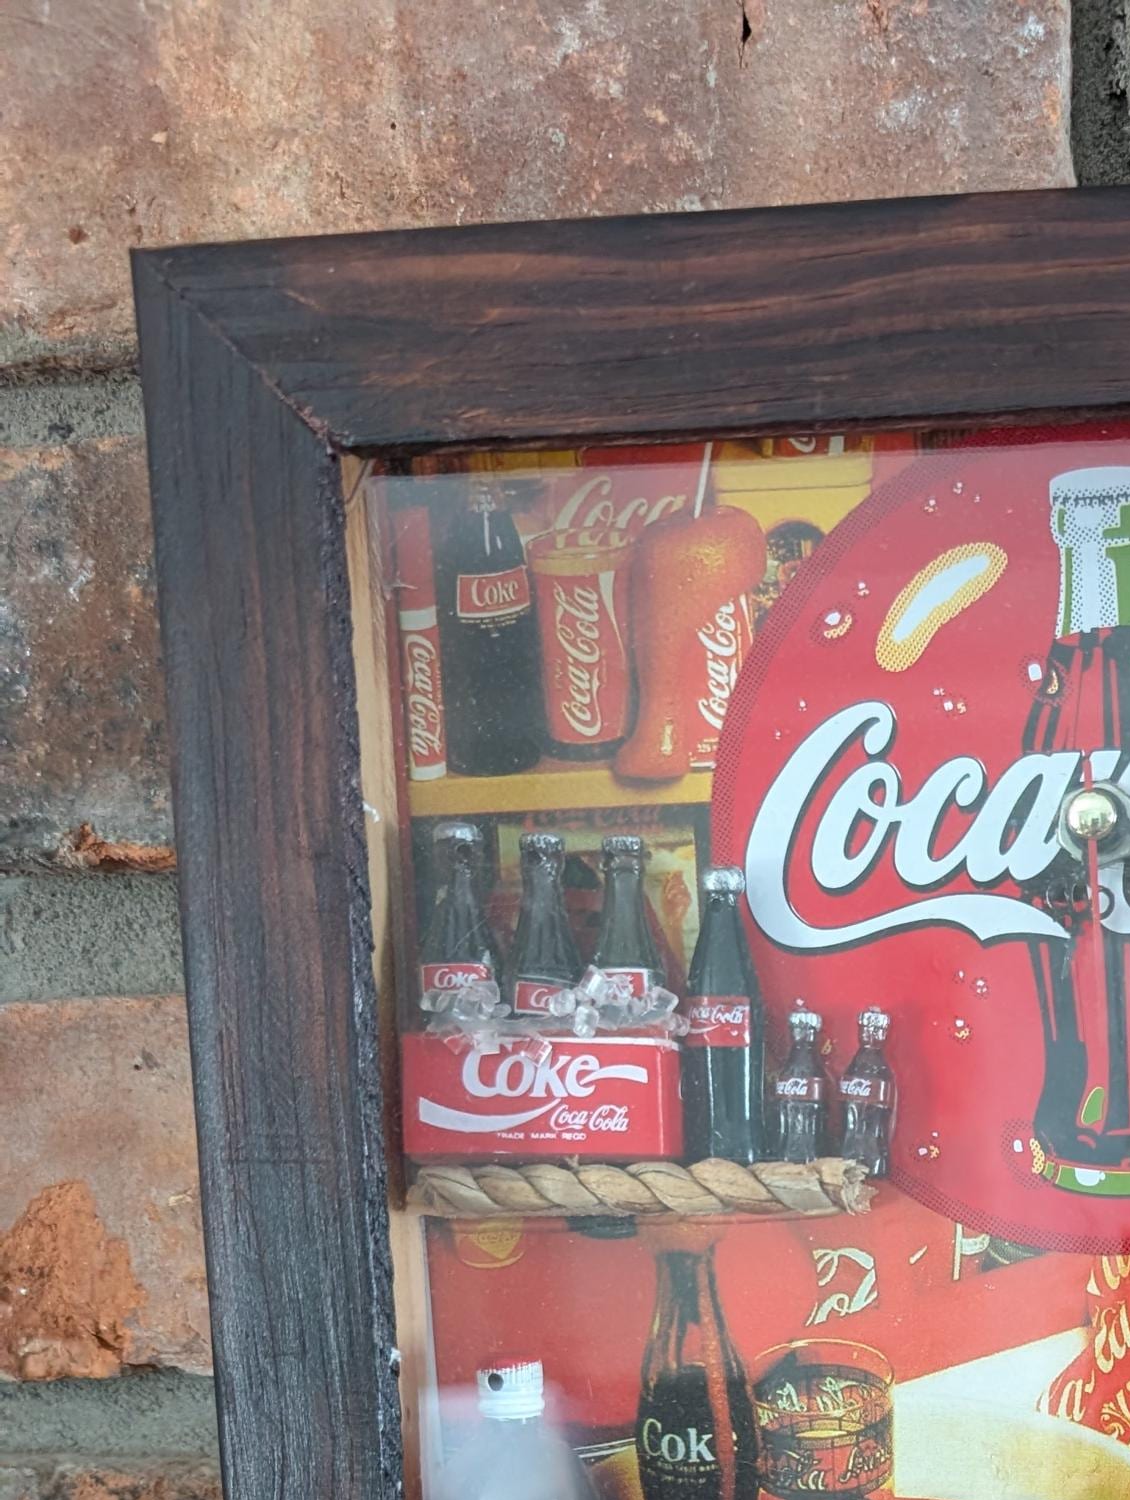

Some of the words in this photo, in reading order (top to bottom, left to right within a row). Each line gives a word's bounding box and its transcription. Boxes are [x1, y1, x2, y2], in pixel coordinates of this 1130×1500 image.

[471, 578, 519, 607] Coke
[554, 579, 601, 737] Coca-Cola
[404, 634, 441, 757] Coca-Cola
[434, 968, 479, 989] Coke
[462, 1046, 612, 1099] Coke
[550, 1104, 629, 1133] Coca-Cola
[643, 1418, 738, 1464] Cok
